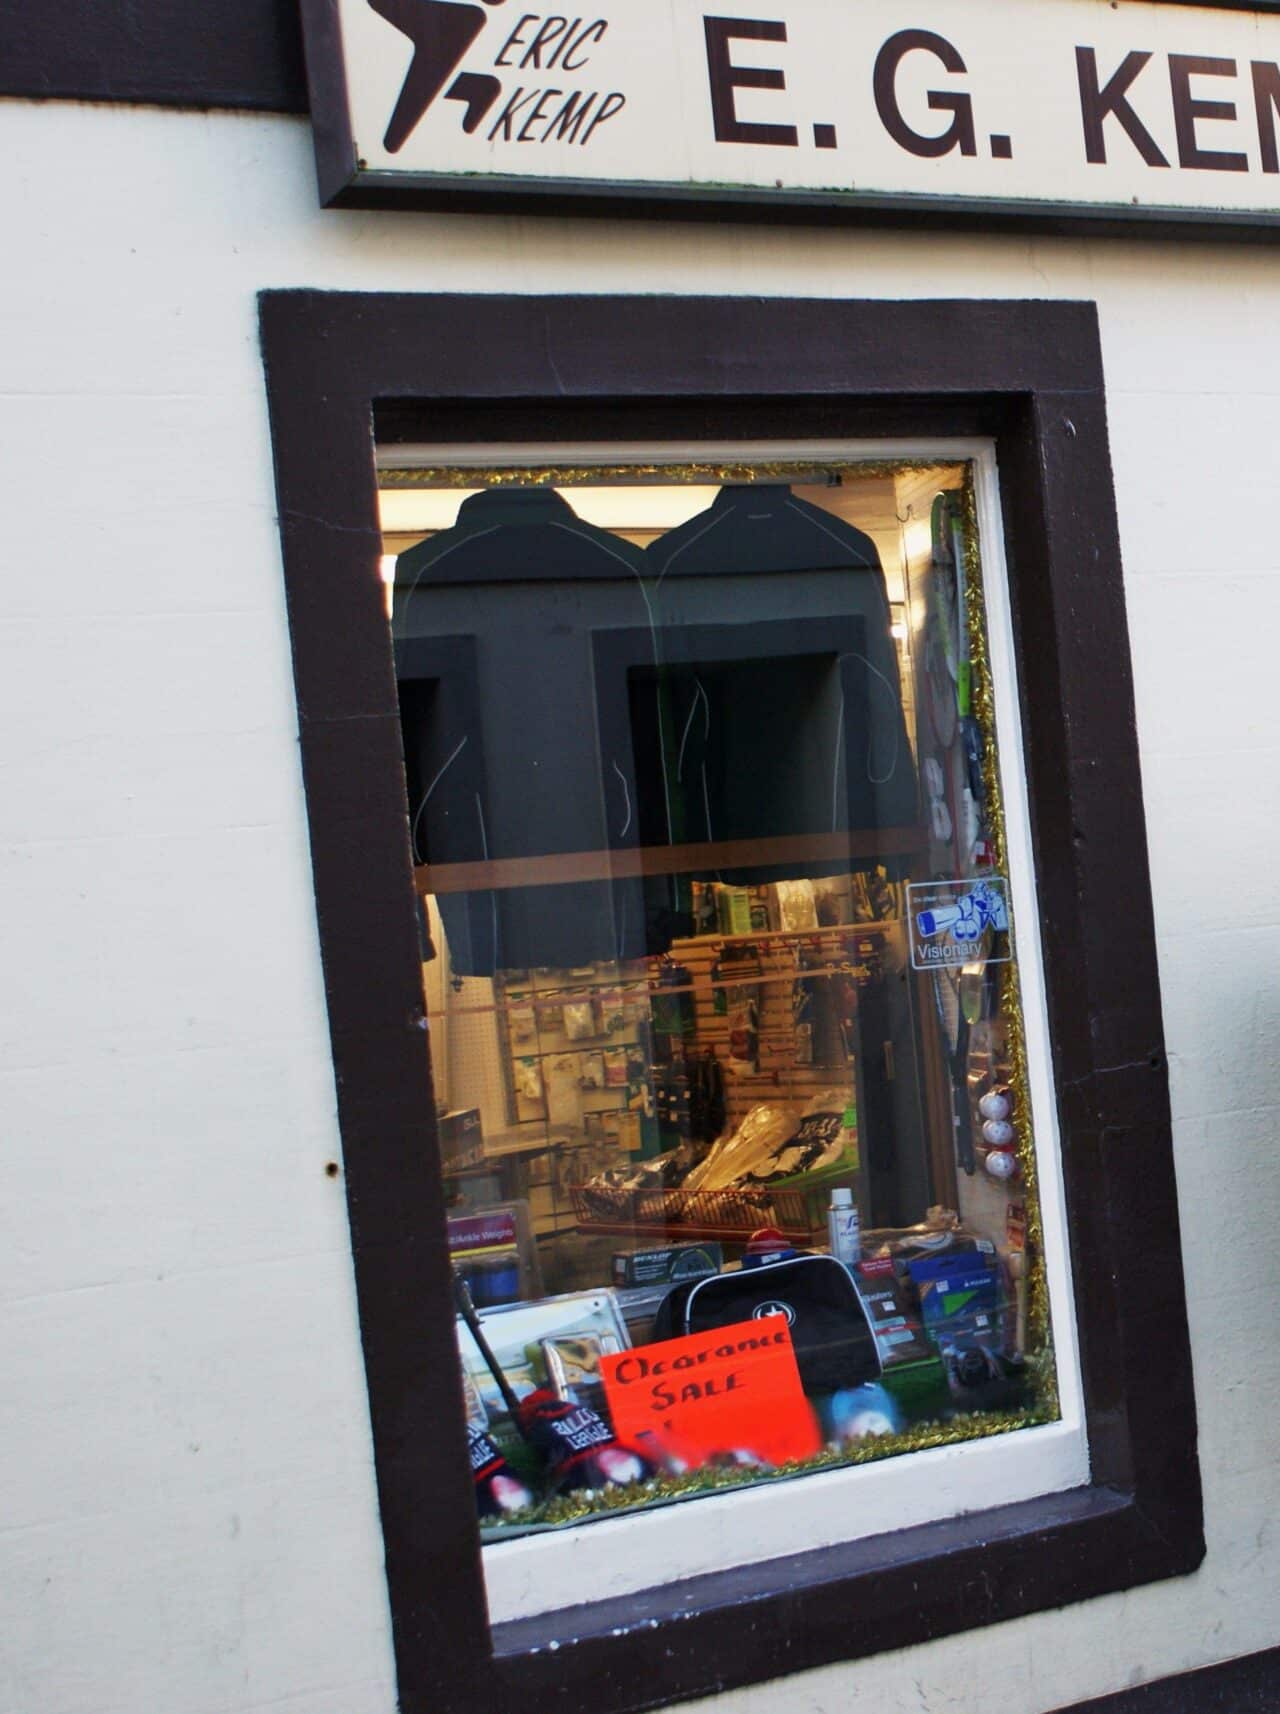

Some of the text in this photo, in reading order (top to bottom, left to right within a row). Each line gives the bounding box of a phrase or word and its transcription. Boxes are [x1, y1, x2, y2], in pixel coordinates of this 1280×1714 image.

[494, 14, 608, 72] ERIC
[488, 86, 626, 146] KEMP
[918, 943, 982, 959] Visionary
[615, 1331, 785, 1384] Clearance
[651, 1370, 746, 1411] SALE
